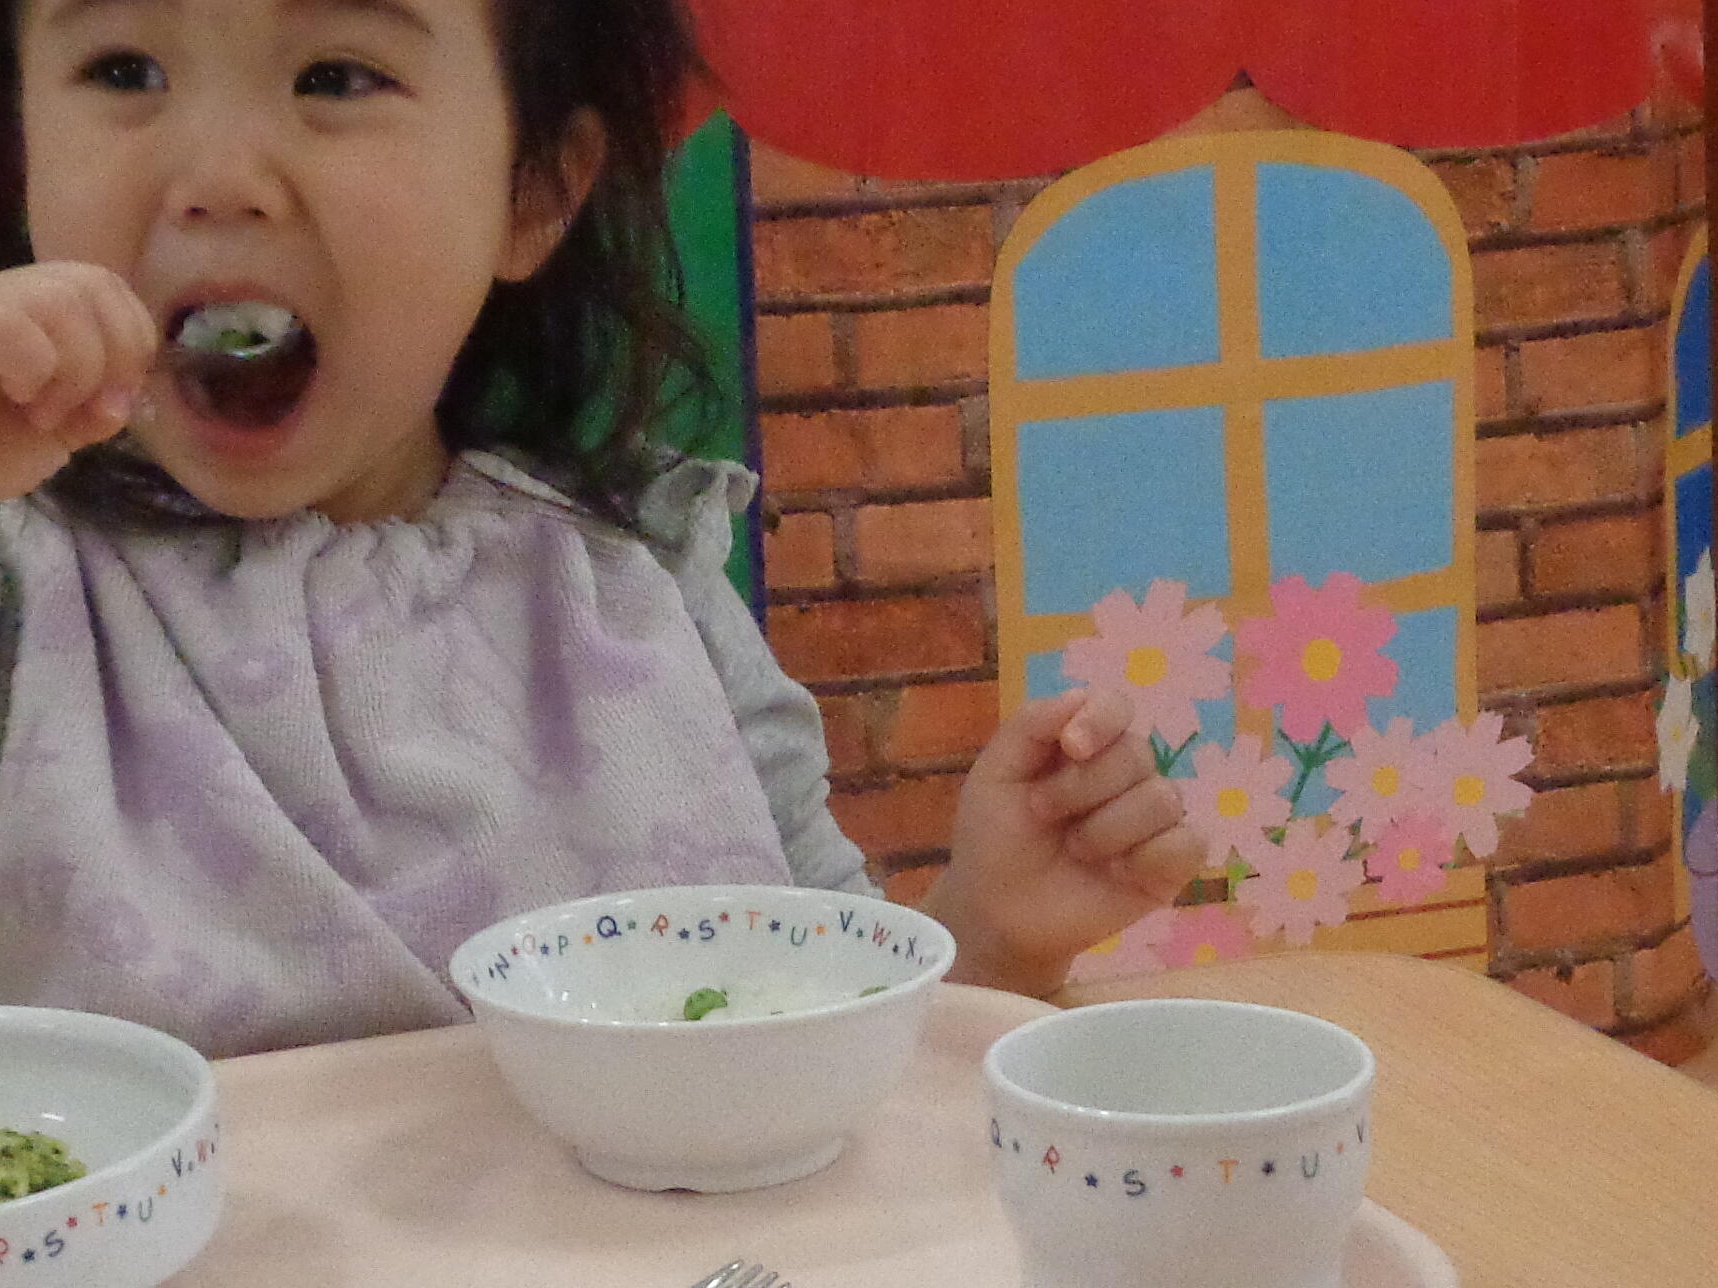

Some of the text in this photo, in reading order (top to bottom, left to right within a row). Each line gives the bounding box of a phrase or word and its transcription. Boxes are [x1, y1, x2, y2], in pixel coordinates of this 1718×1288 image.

[558, 935, 569, 955] P
[597, 915, 622, 938] Q
[651, 914, 669, 936] R
[699, 919, 715, 940] S
[746, 911, 761, 930] T
[791, 926, 807, 946] U
[840, 910, 854, 932] V
[873, 921, 891, 947] W
[906, 936, 918, 959] X
[1042, 1144, 1060, 1174] R
[1123, 1168, 1146, 1197] S
[1219, 1159, 1240, 1182] T
[1302, 1152, 1319, 1178] U
[44, 1229, 64, 1257] S
[91, 1201, 109, 1225] T
[138, 1196, 153, 1222] U
